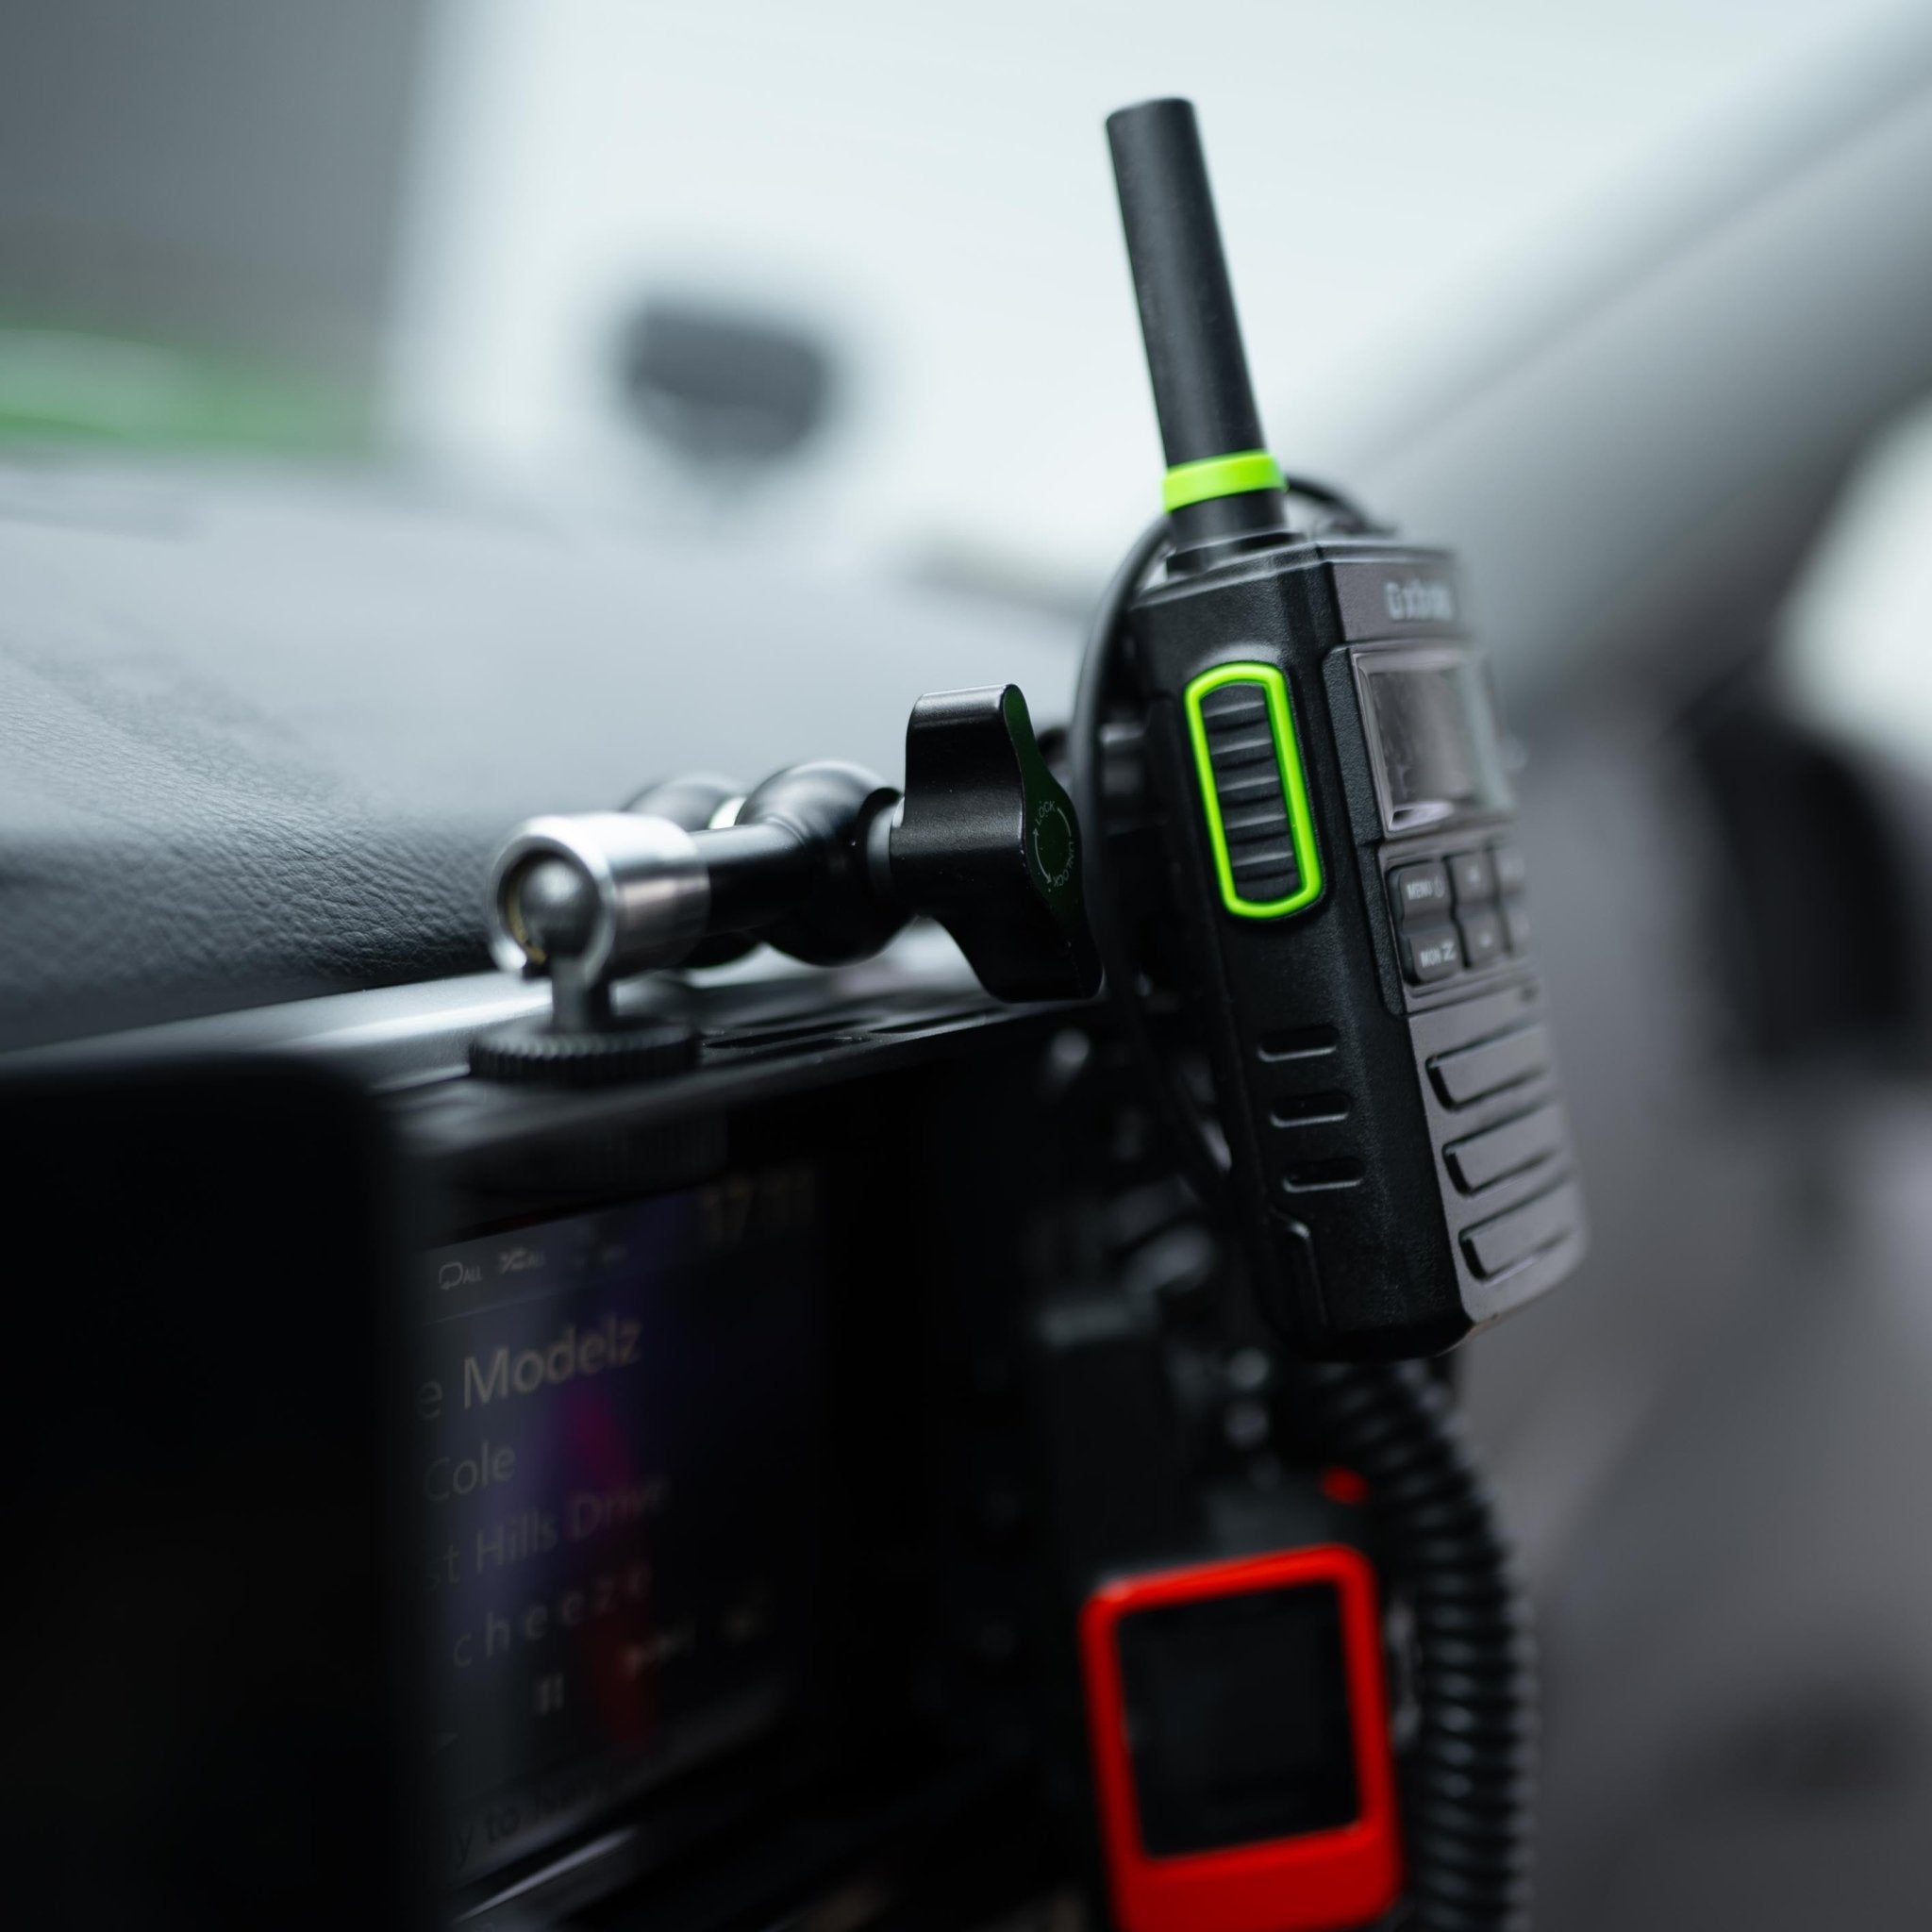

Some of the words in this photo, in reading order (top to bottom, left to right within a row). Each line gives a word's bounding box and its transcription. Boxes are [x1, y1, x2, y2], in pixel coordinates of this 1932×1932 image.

[1035, 799, 1057, 826] LOCK
[1053, 841, 1075, 888] UNLOCK
[463, 1314, 641, 1409] Modelz
[427, 1439, 517, 1502] Cole
[475, 1507, 559, 1574] Hills
